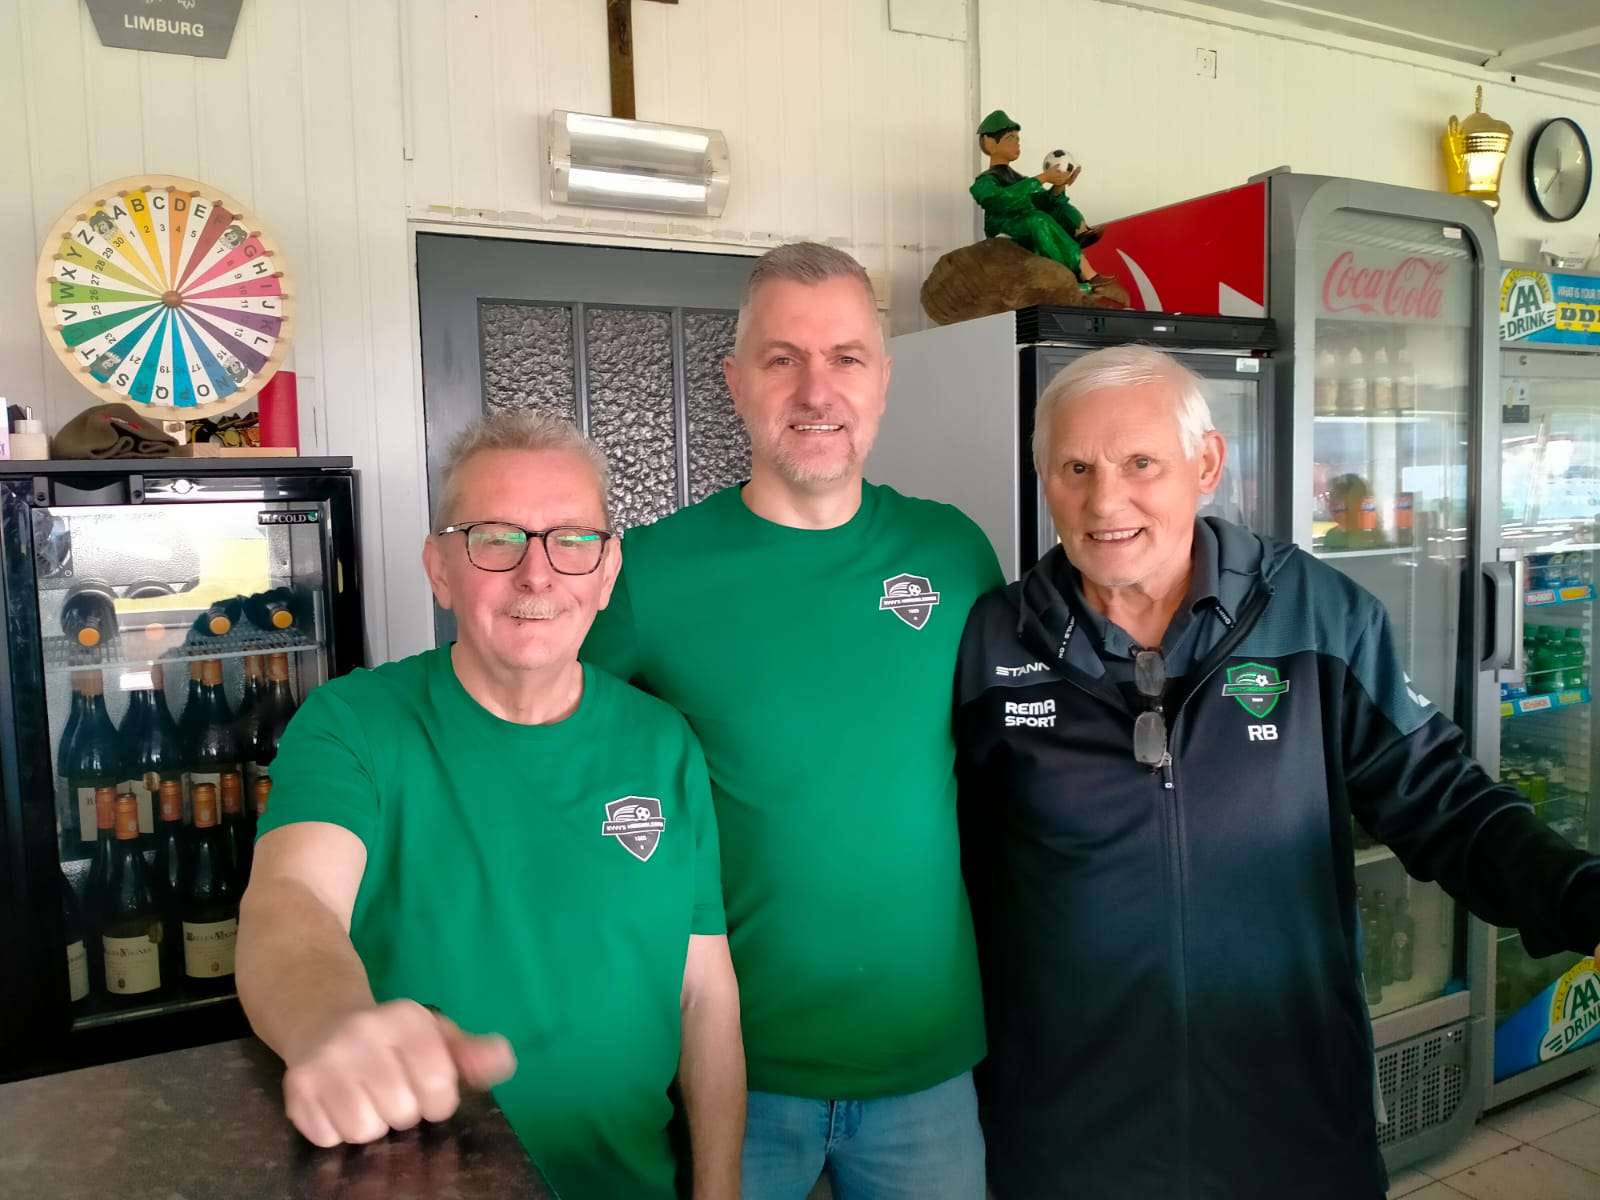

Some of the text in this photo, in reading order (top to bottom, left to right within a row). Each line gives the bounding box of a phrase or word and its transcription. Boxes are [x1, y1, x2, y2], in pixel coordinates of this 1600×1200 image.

[124, 14, 205, 37] LIMBURG
[130, 198, 145, 213] B
[152, 196, 166, 210] C
[174, 197, 186, 212] D
[113, 204, 127, 220] A
[194, 203, 207, 219] E
[143, 225, 151, 234] 2
[159, 223, 166, 232] 3
[190, 230, 197, 238] 5
[77, 229, 95, 245] Z
[66, 246, 83, 258] Y
[102, 247, 114, 259] 29
[244, 244, 257, 258] G
[60, 266, 77, 280] X
[252, 261, 268, 275] H
[90, 273, 101, 286] 27
[1322, 251, 1449, 319] Coca-Cola
[60, 281, 75, 300] W
[241, 300, 249, 308] 11
[262, 300, 275, 309] J
[1512, 284, 1542, 317] AA
[62, 309, 78, 321] V
[91, 304, 102, 316] 25
[1507, 309, 1547, 338] DRINK
[253, 336, 268, 345] L
[81, 348, 97, 360] T
[129, 354, 141, 364] 21
[159, 365, 171, 374] 19
[191, 363, 202, 373] 17
[116, 373, 130, 387] S
[155, 384, 169, 400] Q
[196, 383, 210, 397] O
[1005, 699, 1056, 715] REMA
[1004, 715, 1056, 728] SPORT
[1247, 724, 1279, 741] RB
[1570, 978, 1600, 1020] AA
